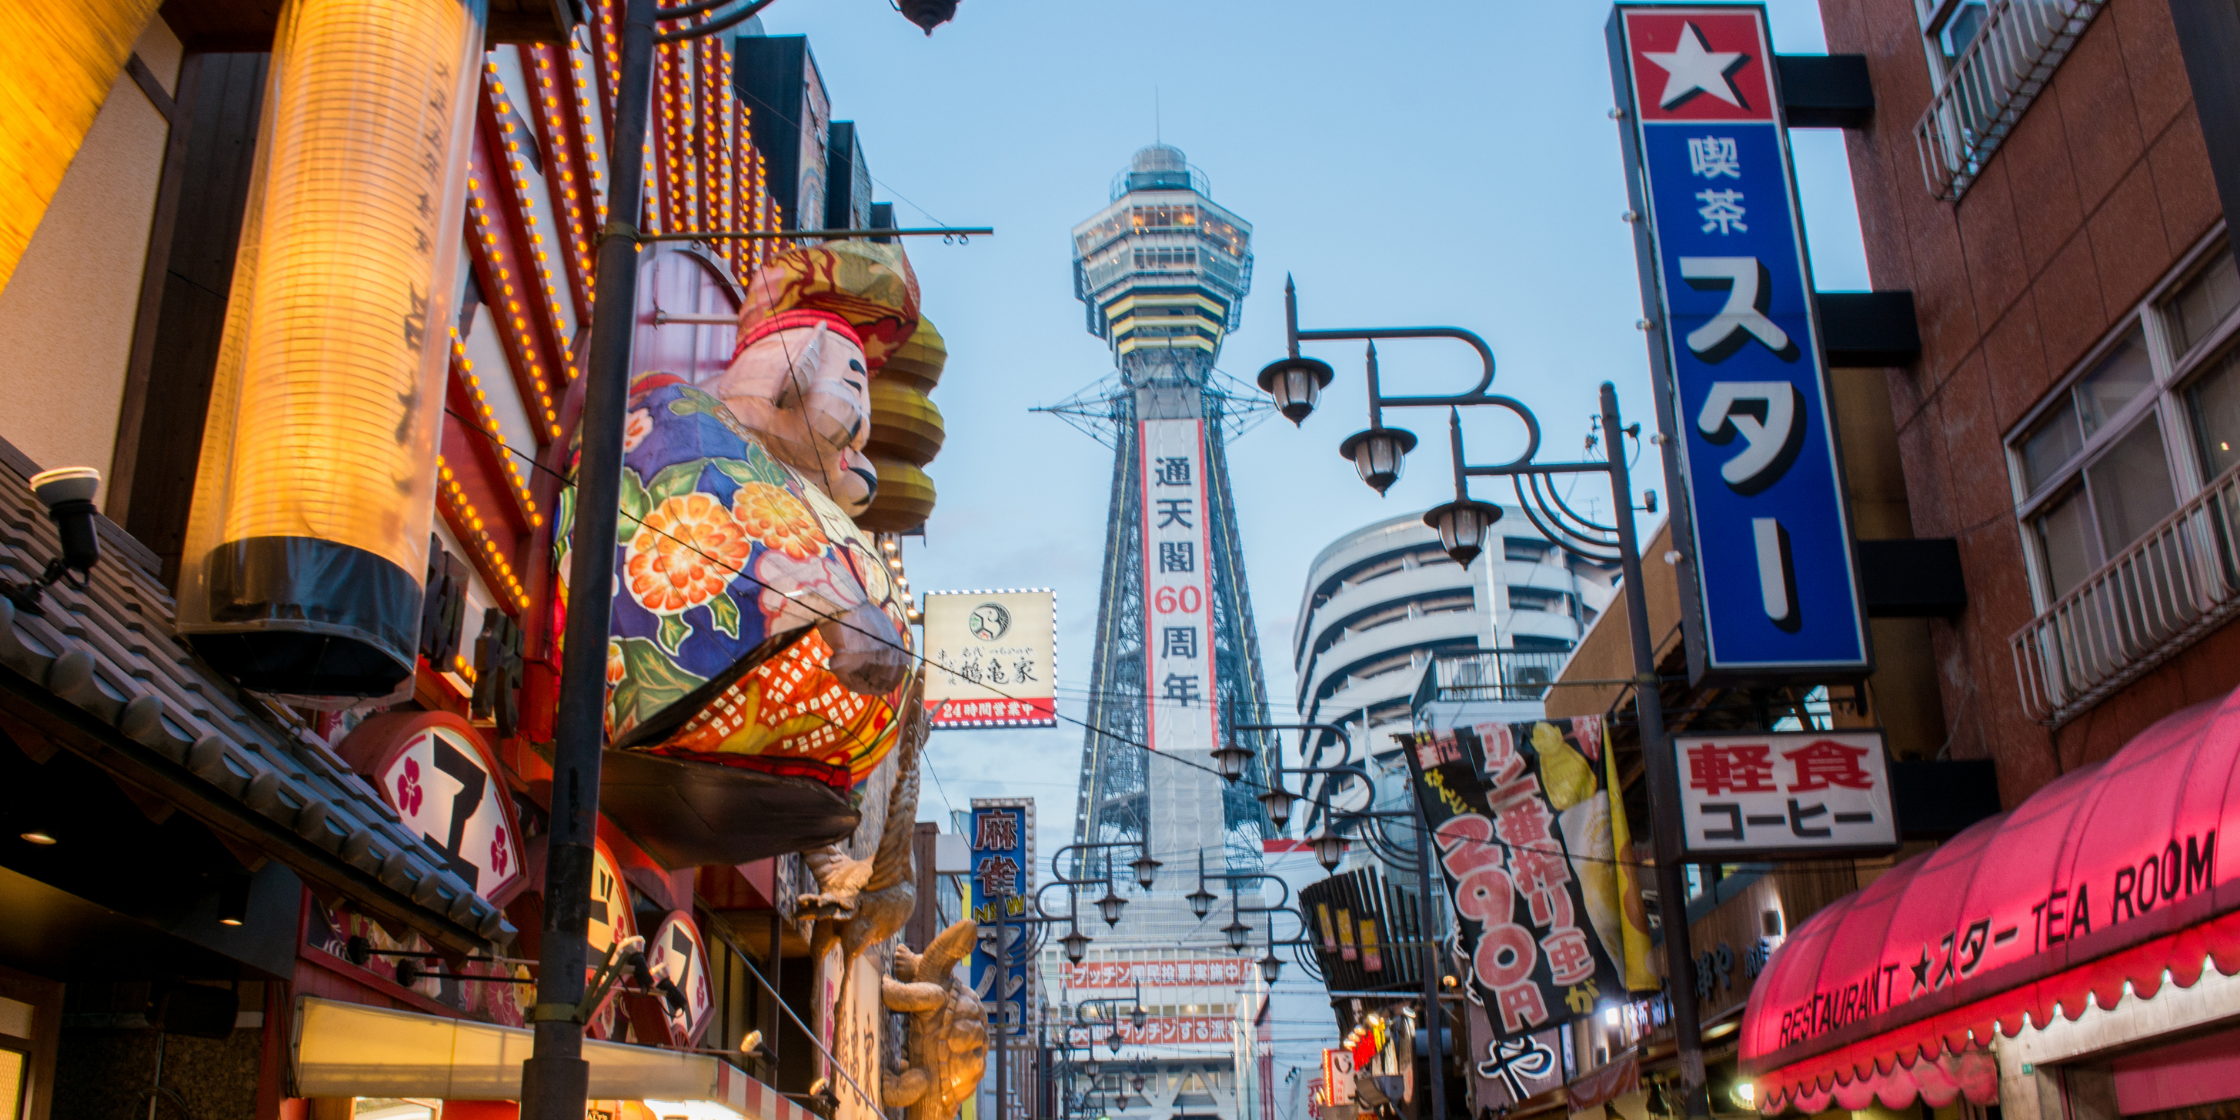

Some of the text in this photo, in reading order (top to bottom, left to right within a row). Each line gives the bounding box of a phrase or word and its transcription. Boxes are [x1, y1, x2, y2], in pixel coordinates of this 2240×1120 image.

[1686, 135, 1748, 236] 喫茶
[1678, 256, 1799, 628] スター
[942, 701, 1034, 718] 24時間営業中
[1686, 740, 1874, 796] 軽食
[974, 810, 1020, 897] 麻雀
[1699, 799, 1874, 841] コーヒー
[1432, 812, 1549, 1035] 290円
[1779, 963, 1900, 1050] RESTAURANT
[2031, 882, 2092, 955] TEA
[2112, 829, 2217, 925] ROOM
